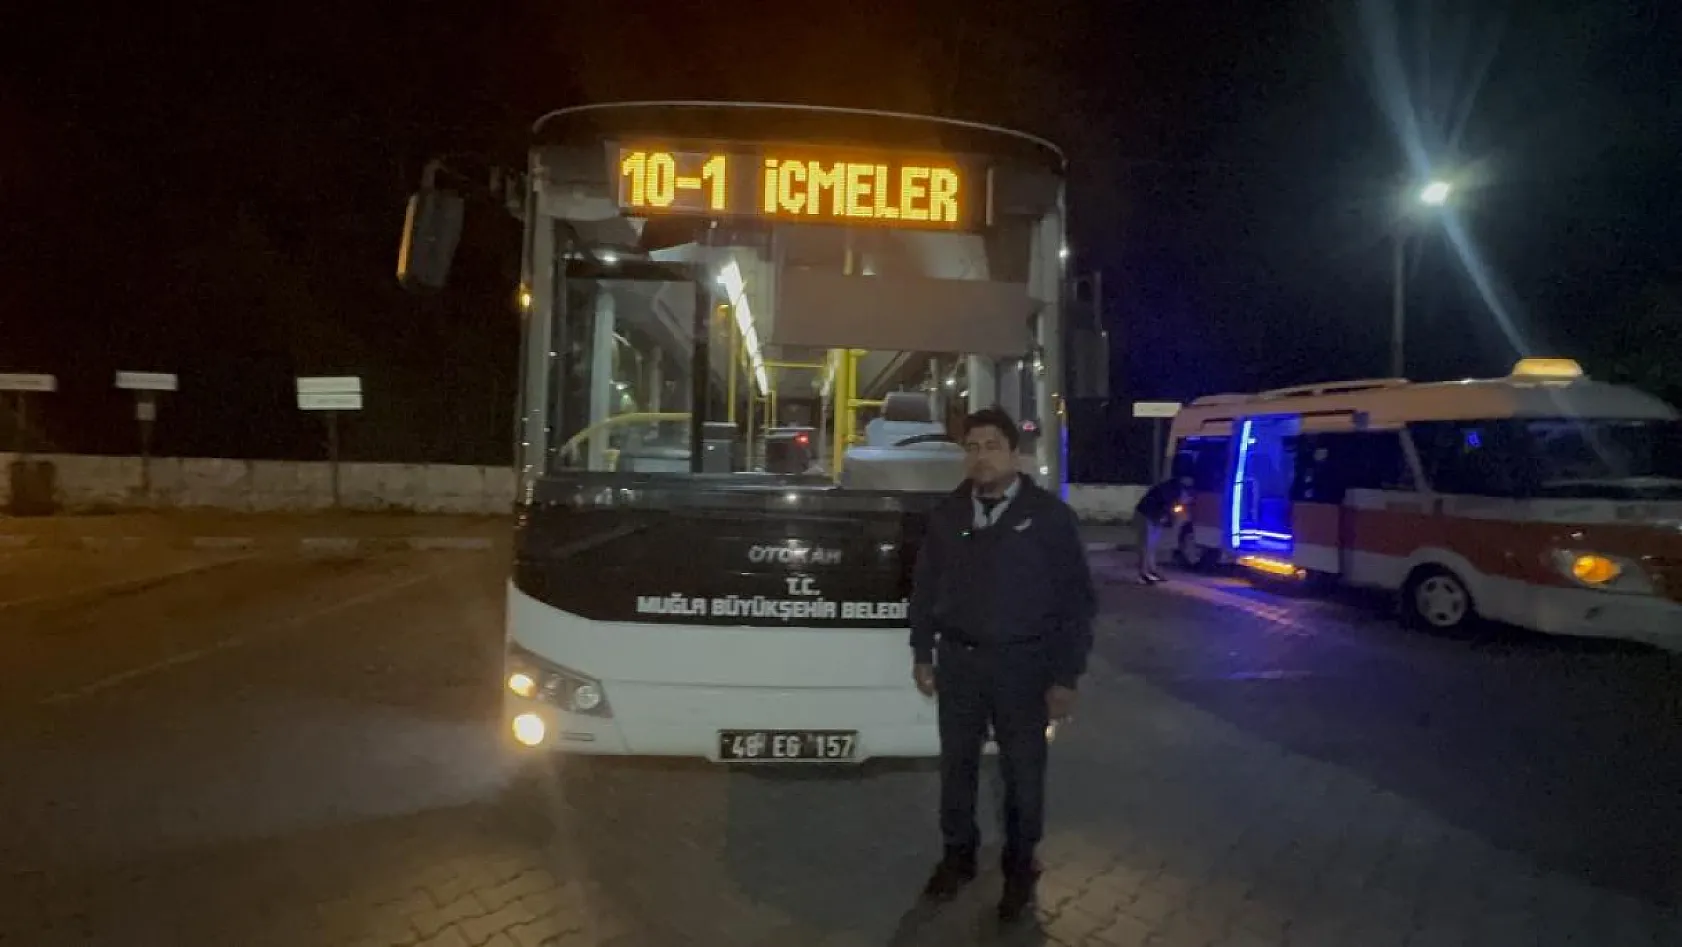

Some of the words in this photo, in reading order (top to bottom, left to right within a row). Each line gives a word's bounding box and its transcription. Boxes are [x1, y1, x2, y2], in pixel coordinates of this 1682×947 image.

[621, 151, 726, 210] 10-1
[637, 592, 706, 616] MUĞLA
[711, 595, 836, 621] BÜYÜKŞEHİR
[840, 598, 910, 619] BELEDİ
[732, 735, 760, 758] 48
[815, 735, 853, 757] 157
